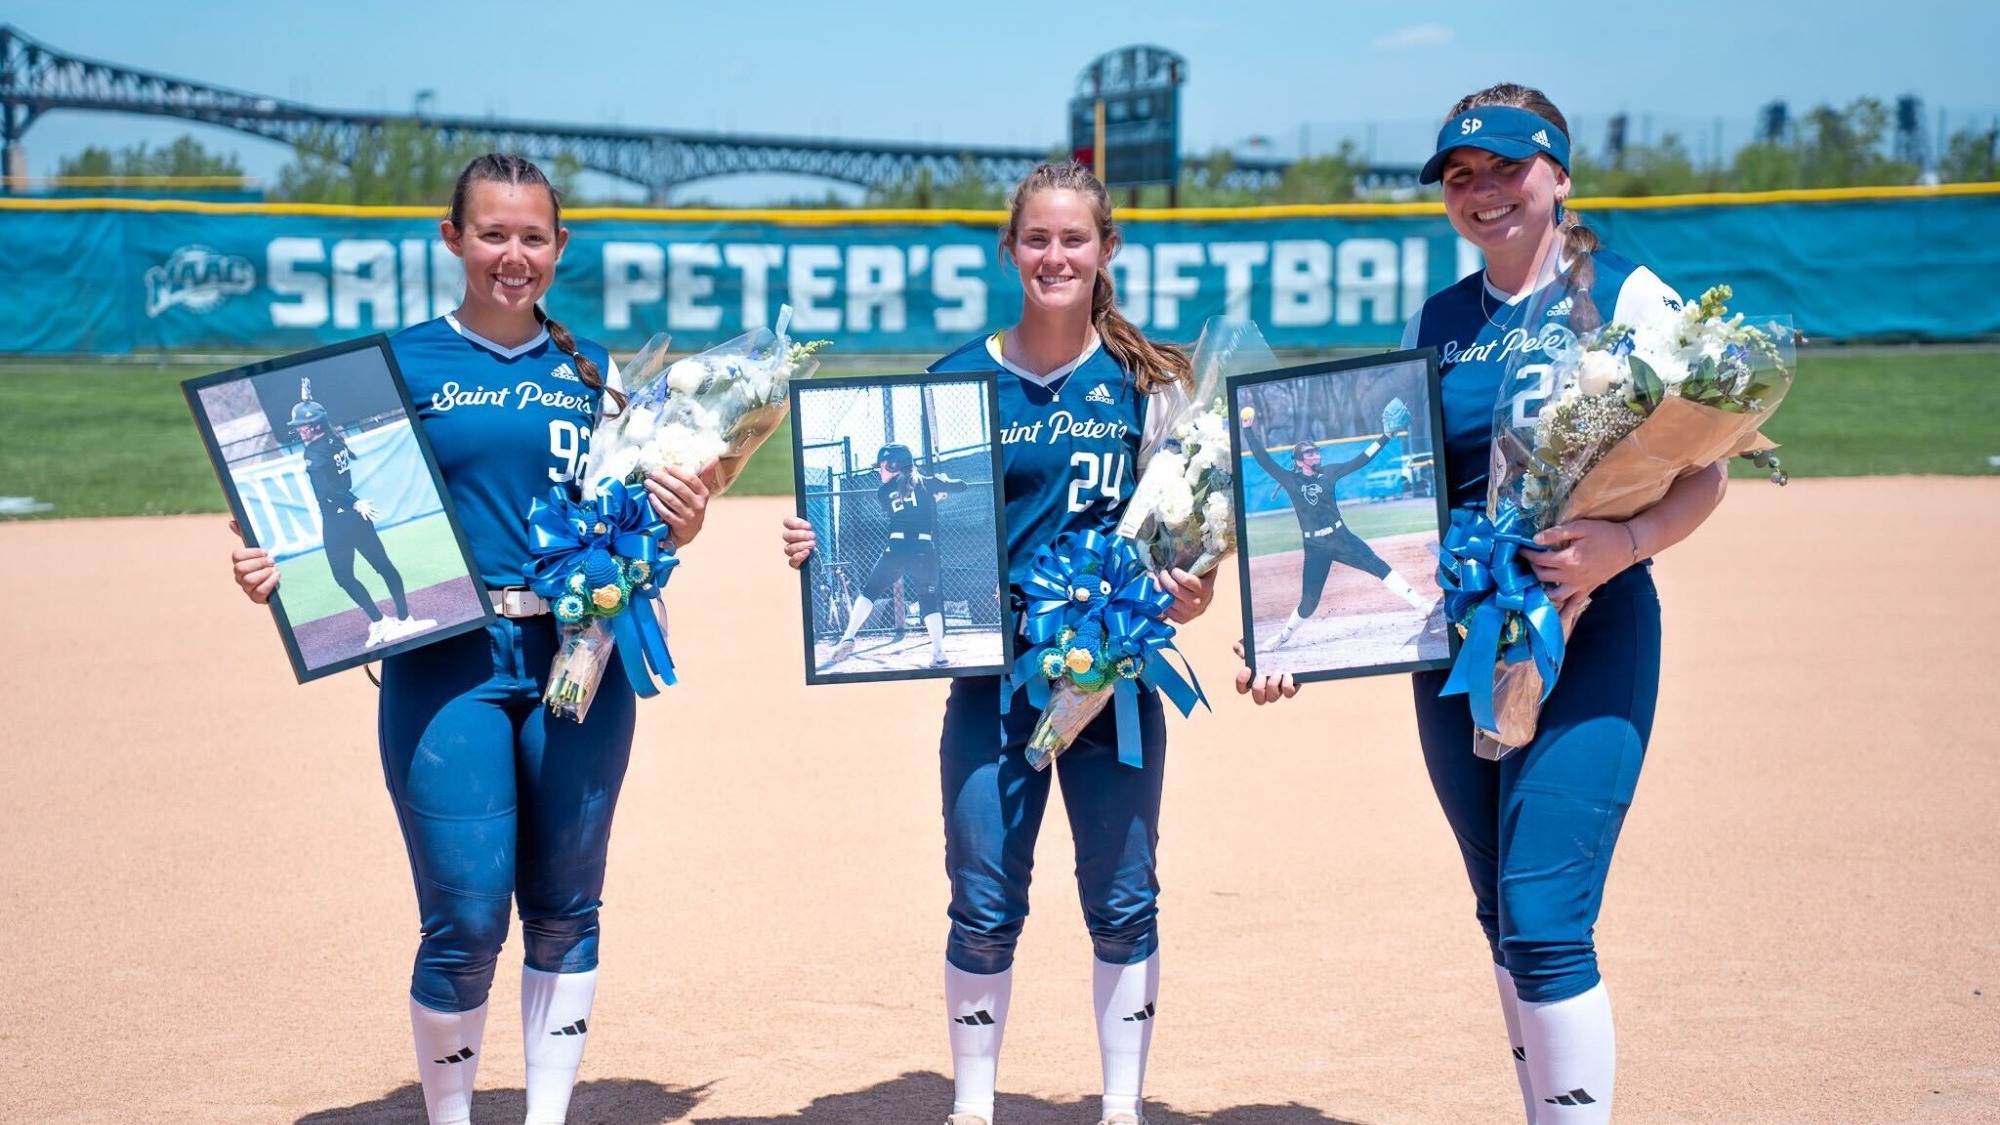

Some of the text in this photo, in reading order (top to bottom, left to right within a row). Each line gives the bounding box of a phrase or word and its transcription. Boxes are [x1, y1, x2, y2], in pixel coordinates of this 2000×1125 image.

[1461, 118, 1483, 135] SP
[266, 237, 464, 330] SAI
[602, 242, 987, 332] PETER'S
[431, 381, 593, 414] Saint Peter's
[1085, 395, 1115, 405] adidas
[1000, 410, 1128, 445] aint Peter's
[1067, 451, 1125, 514] 24
